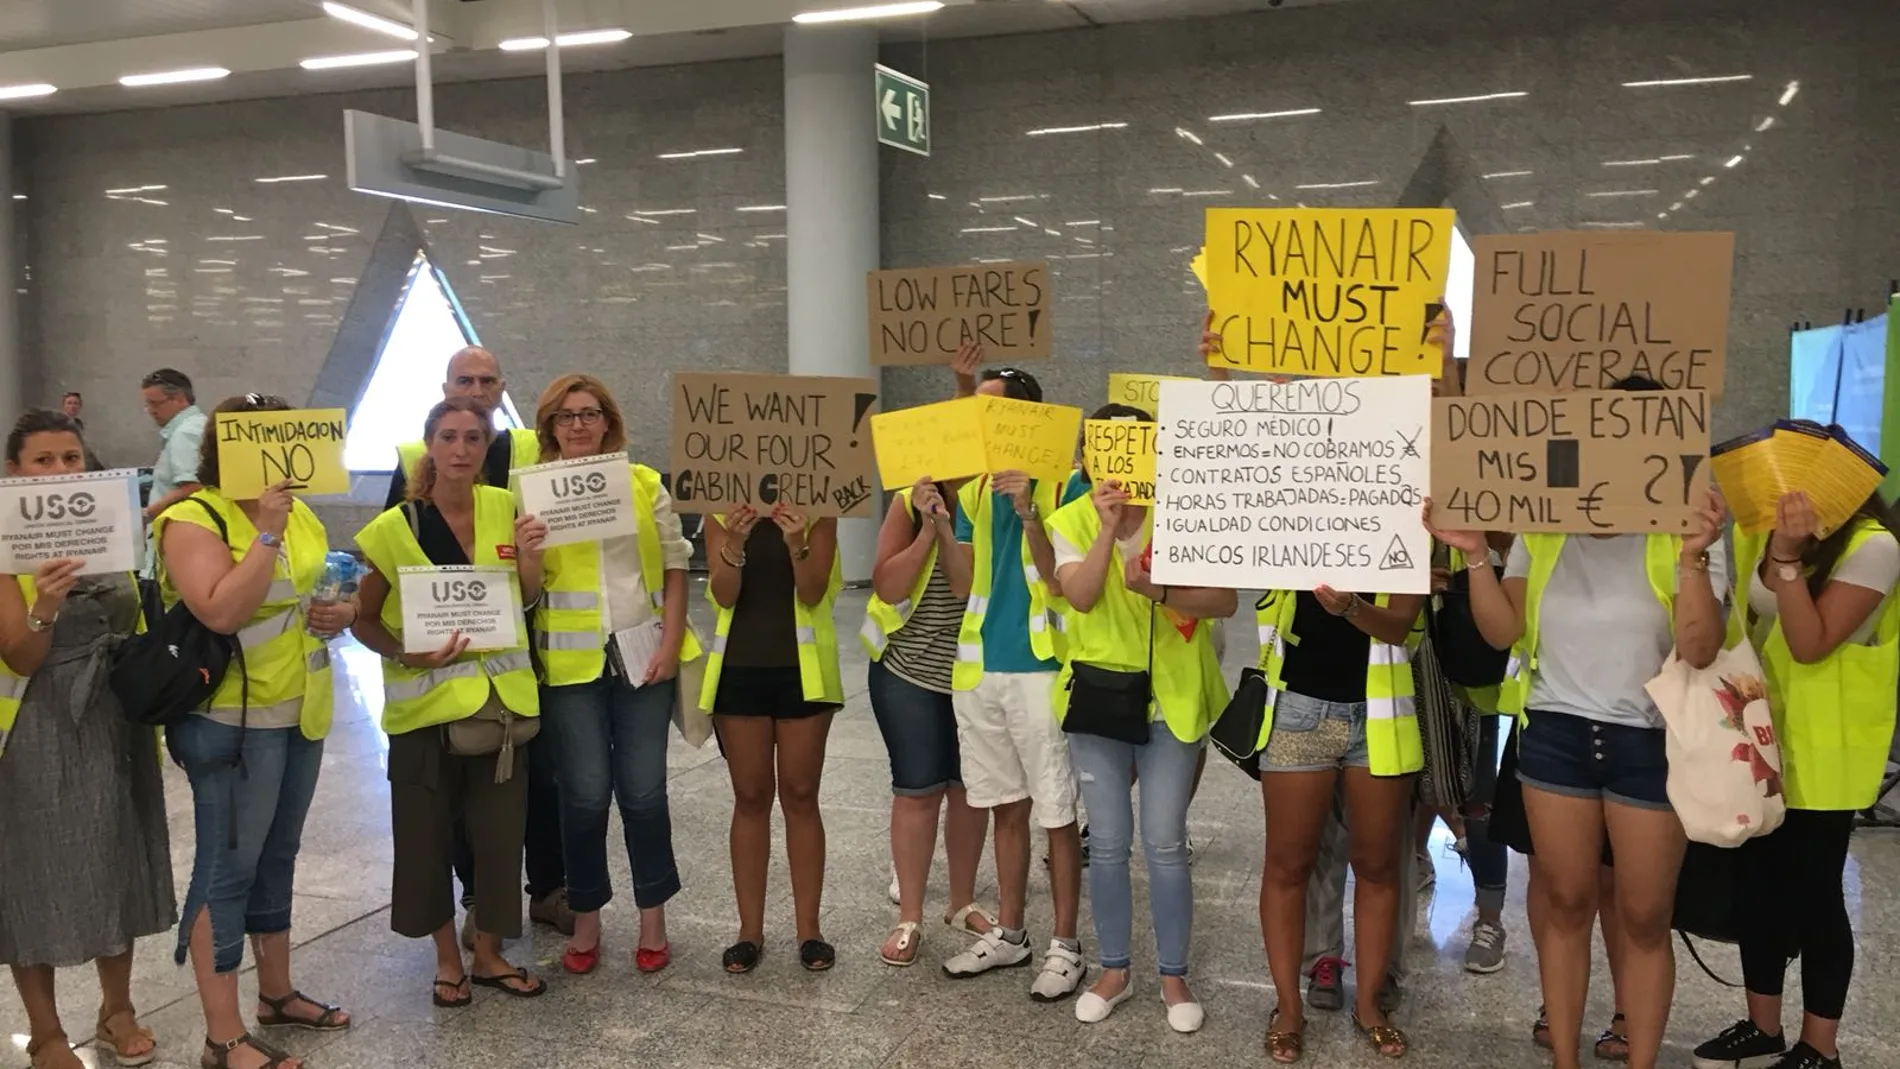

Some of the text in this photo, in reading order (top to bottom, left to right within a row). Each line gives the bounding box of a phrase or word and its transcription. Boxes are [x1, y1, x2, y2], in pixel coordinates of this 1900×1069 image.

[1235, 218, 1434, 282] RYANAIR
[1492, 249, 1594, 296] FULL
[878, 269, 1041, 312] LOW FARES
[1283, 279, 1399, 325] MUST
[882, 320, 928, 354] NO
[1507, 302, 1671, 345] SOCIAL
[1484, 349, 1712, 390] COVERAGE
[682, 383, 827, 427] WE WANT
[1211, 381, 1361, 414] QUEREMOS
[1174, 418, 1247, 439] SEGURO
[1448, 391, 1706, 442] DONDE ESTAN
[219, 419, 344, 444] INTIMIDACION
[994, 422, 1042, 440] MUST
[685, 432, 835, 470] OUR FOUR
[1303, 440, 1395, 459] COBRAMOS
[261, 443, 315, 487] NO
[1093, 455, 1134, 475] A LOS
[1170, 461, 1402, 485] CONTRATOS ESPAÑOLES
[1478, 449, 1537, 481] MIS
[551, 472, 607, 498] USO
[832, 475, 872, 509] BACK
[19, 492, 96, 521] USO
[571, 503, 591, 512] MUST
[1165, 492, 1227, 511] HORAS
[1446, 487, 1501, 523] 40
[1509, 494, 1562, 523] MIL
[1, 525, 115, 541] RYANAIR MUST CHANGE
[1166, 515, 1381, 533] IGUALDAD CONDICIONES
[15, 546, 107, 560] RIGHTS AT RYANAIR
[34, 541, 52, 549] MIS
[54, 536, 108, 548] DERECHOS
[1168, 542, 1371, 568] BANCOS IRLANDESES
[1388, 550, 1409, 564] NO
[432, 580, 488, 602] USO
